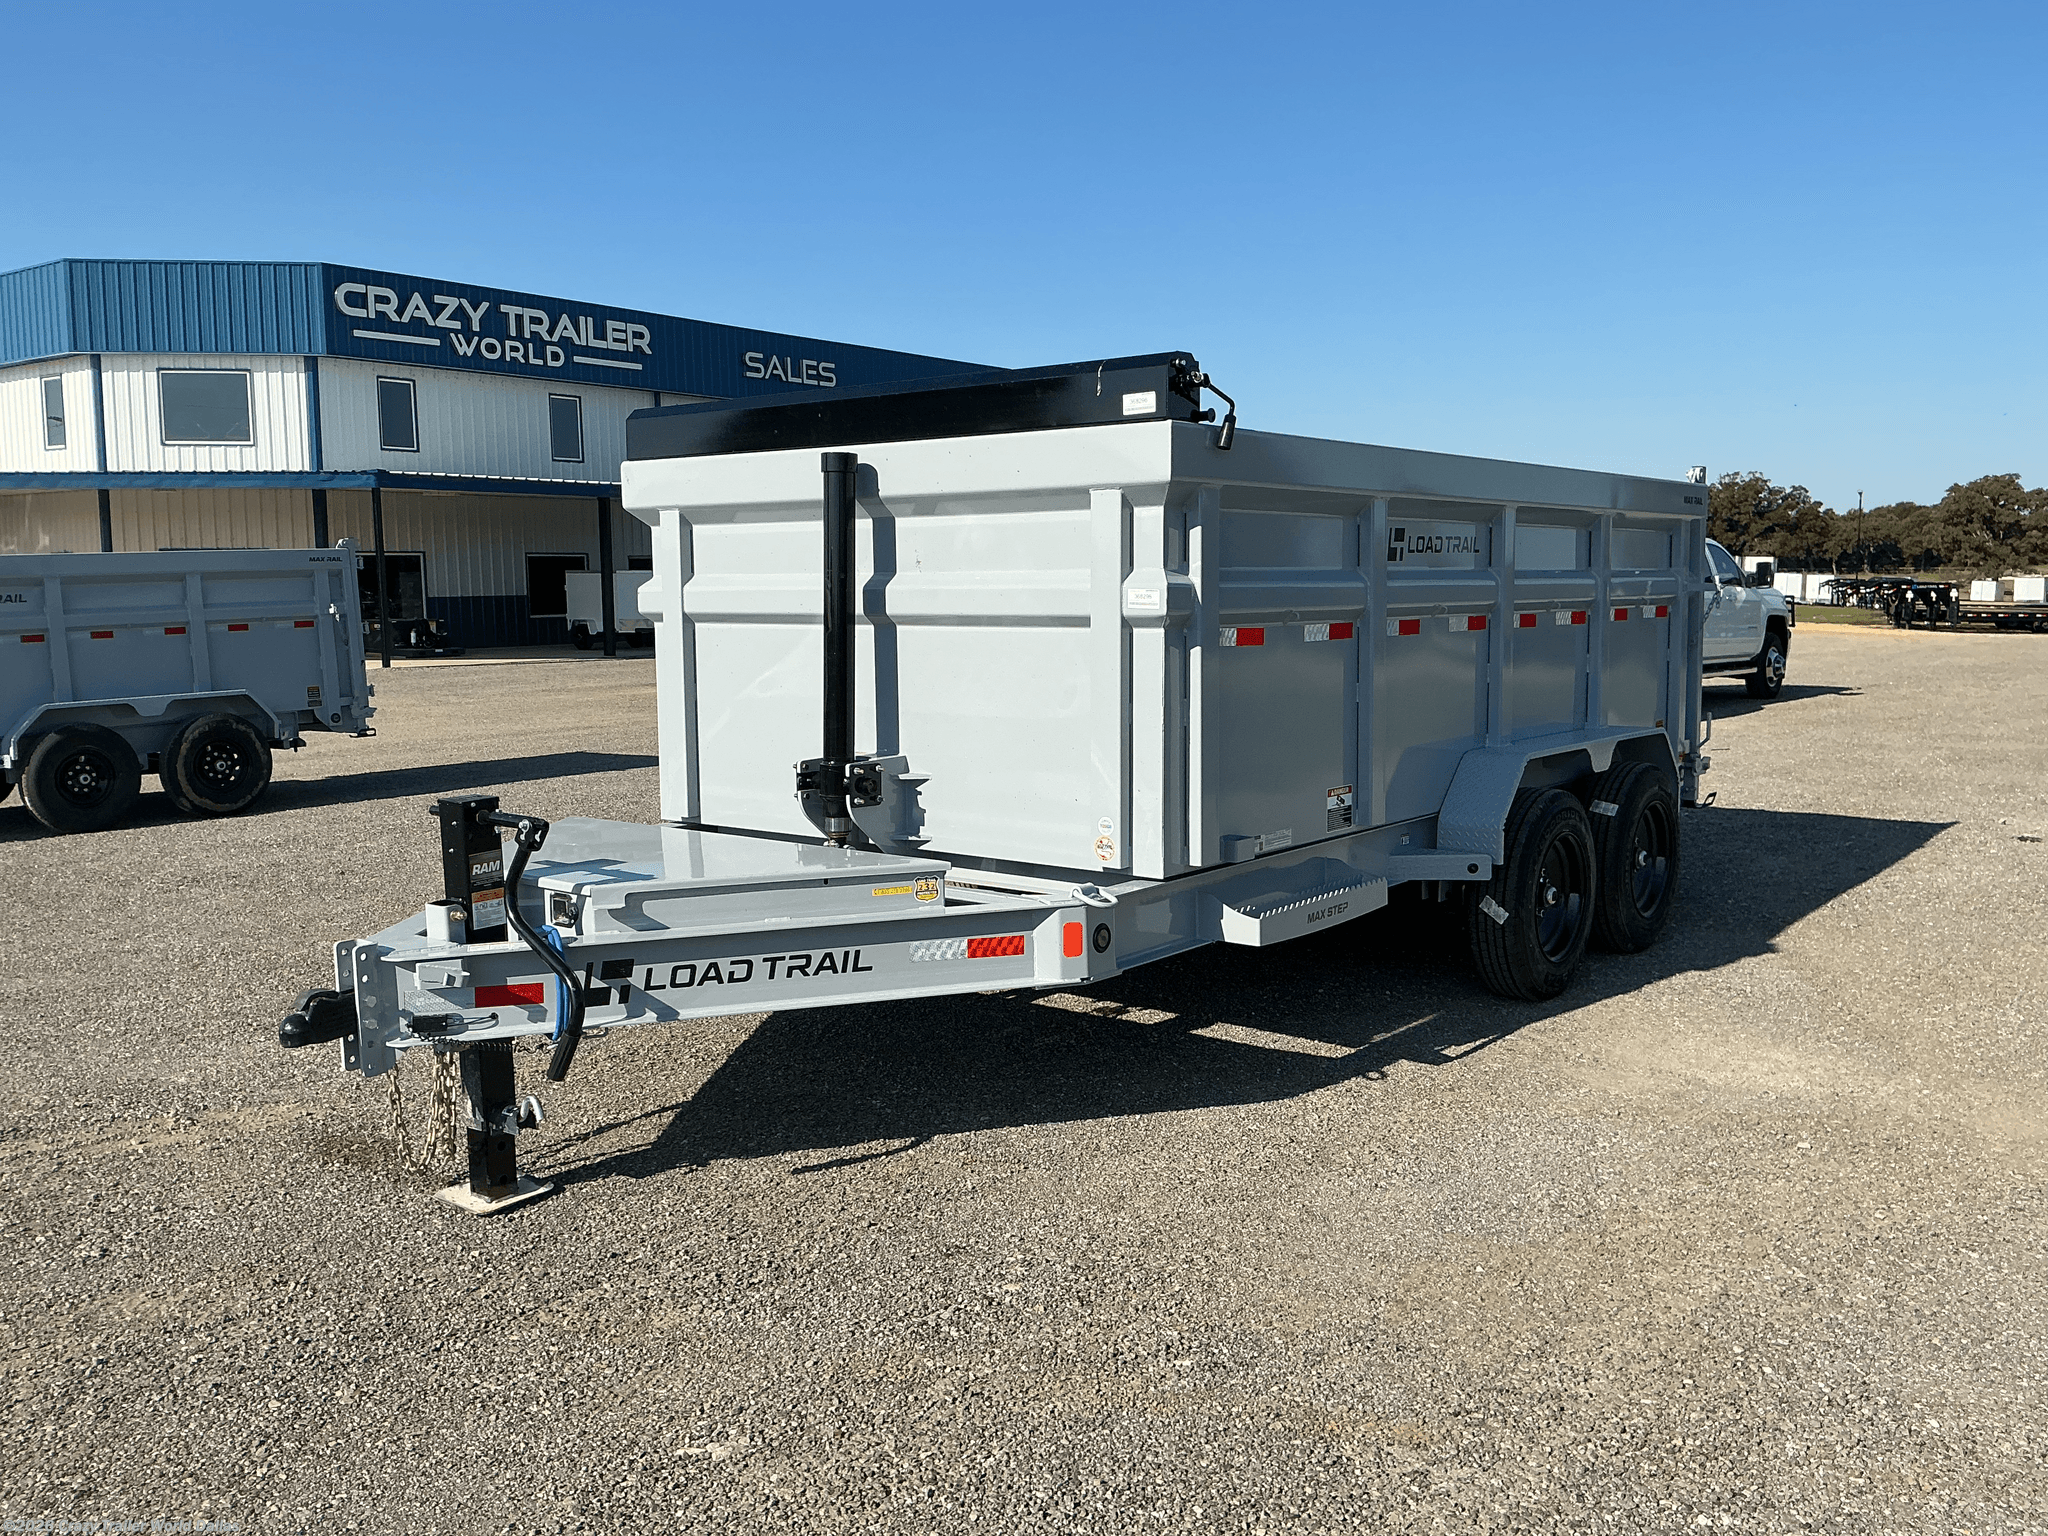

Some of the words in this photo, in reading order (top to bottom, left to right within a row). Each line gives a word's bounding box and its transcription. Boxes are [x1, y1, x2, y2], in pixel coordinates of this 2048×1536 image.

[334, 282, 490, 332] CRAZY
[499, 304, 653, 355] TRAILER
[450, 332, 565, 368] WORLD
[744, 351, 837, 388] SALES
[1407, 535, 1443, 554] LOAD
[1445, 535, 1480, 554] TRAIL
[472, 860, 501, 876] RAM
[1307, 908, 1327, 924] MAX
[1327, 901, 1349, 918] STEP
[643, 958, 754, 992] LOAD
[762, 949, 874, 980] TRAIL
